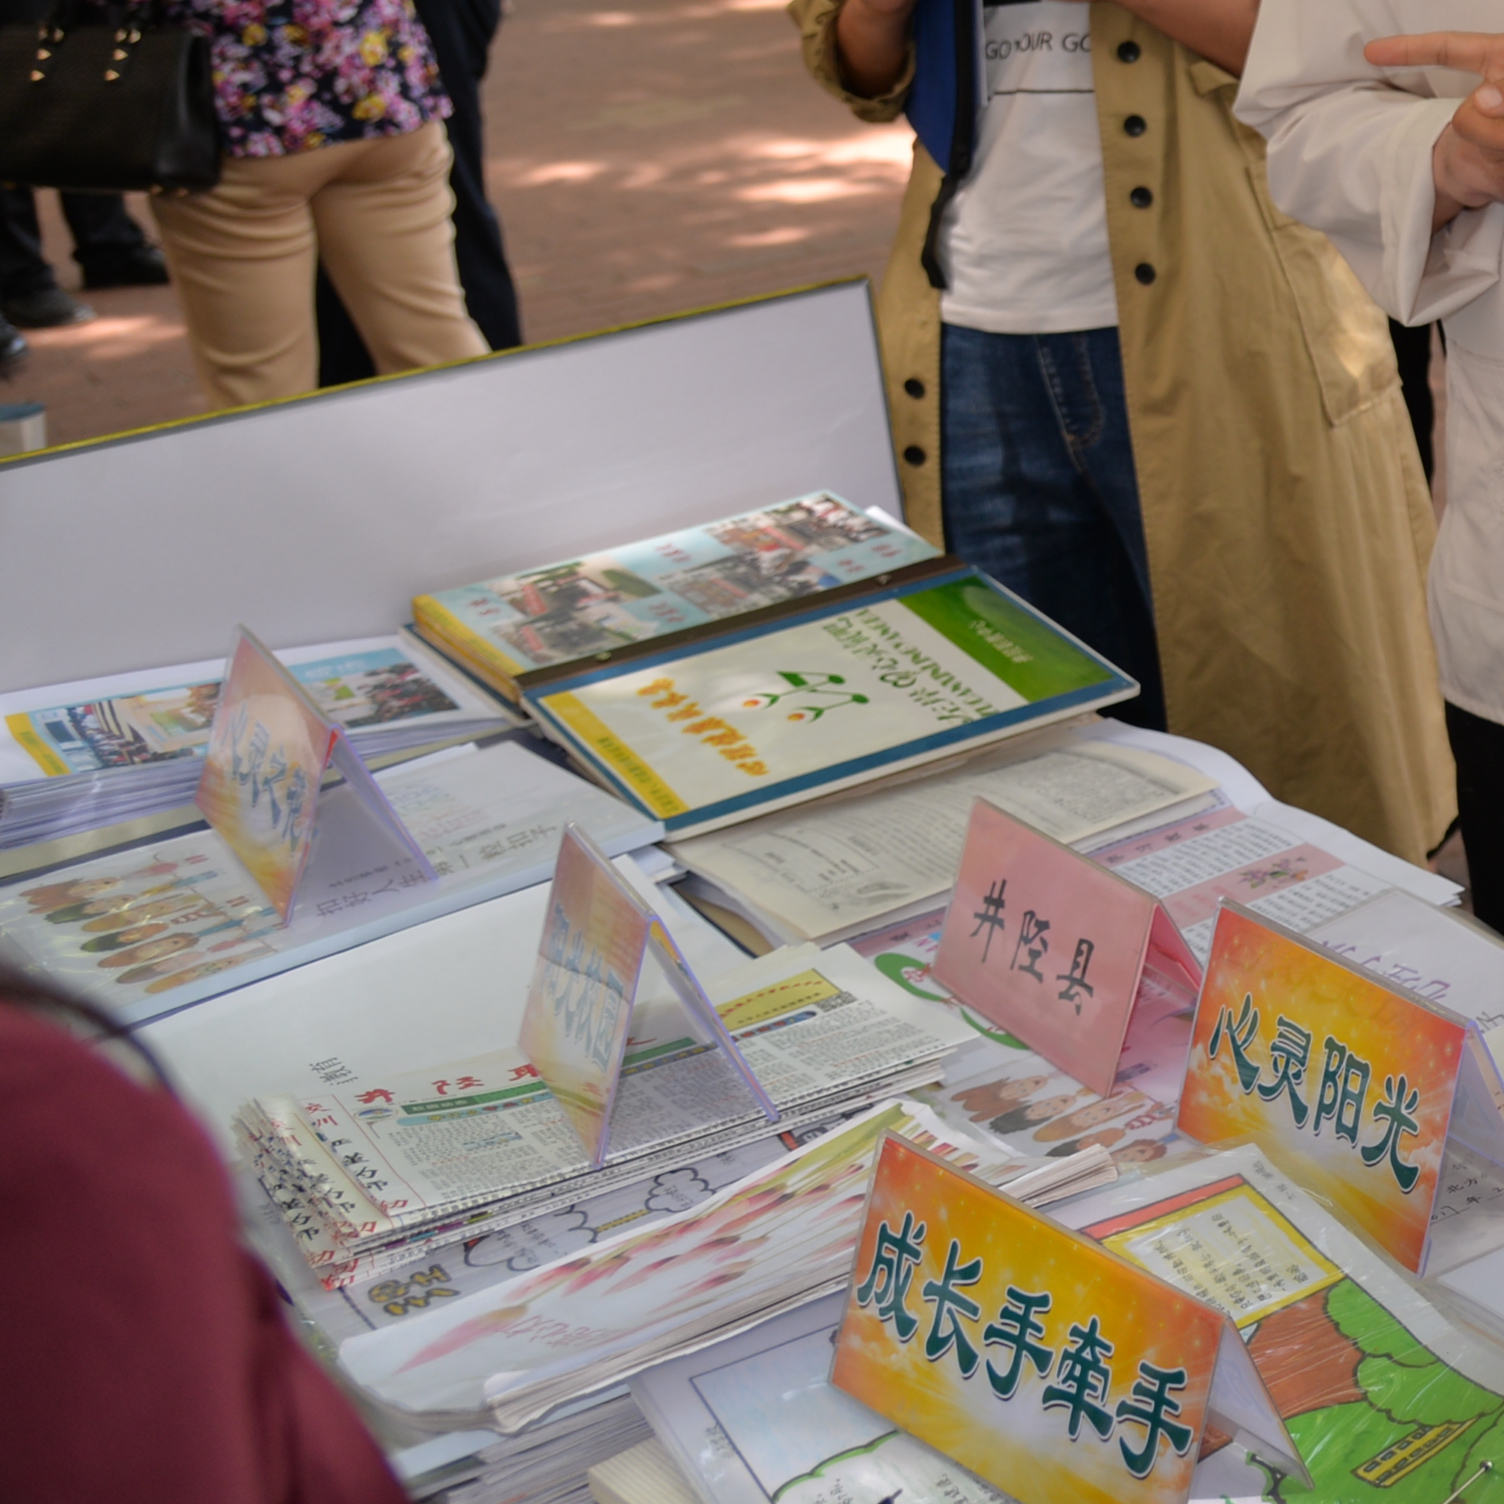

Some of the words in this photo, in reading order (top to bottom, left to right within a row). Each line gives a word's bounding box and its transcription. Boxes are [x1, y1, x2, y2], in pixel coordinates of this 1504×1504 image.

[971, 878, 1095, 1017] 井陉县
[1208, 992, 1421, 1194] 心灵阳光
[856, 1212, 1194, 1480] 成长手牵手
